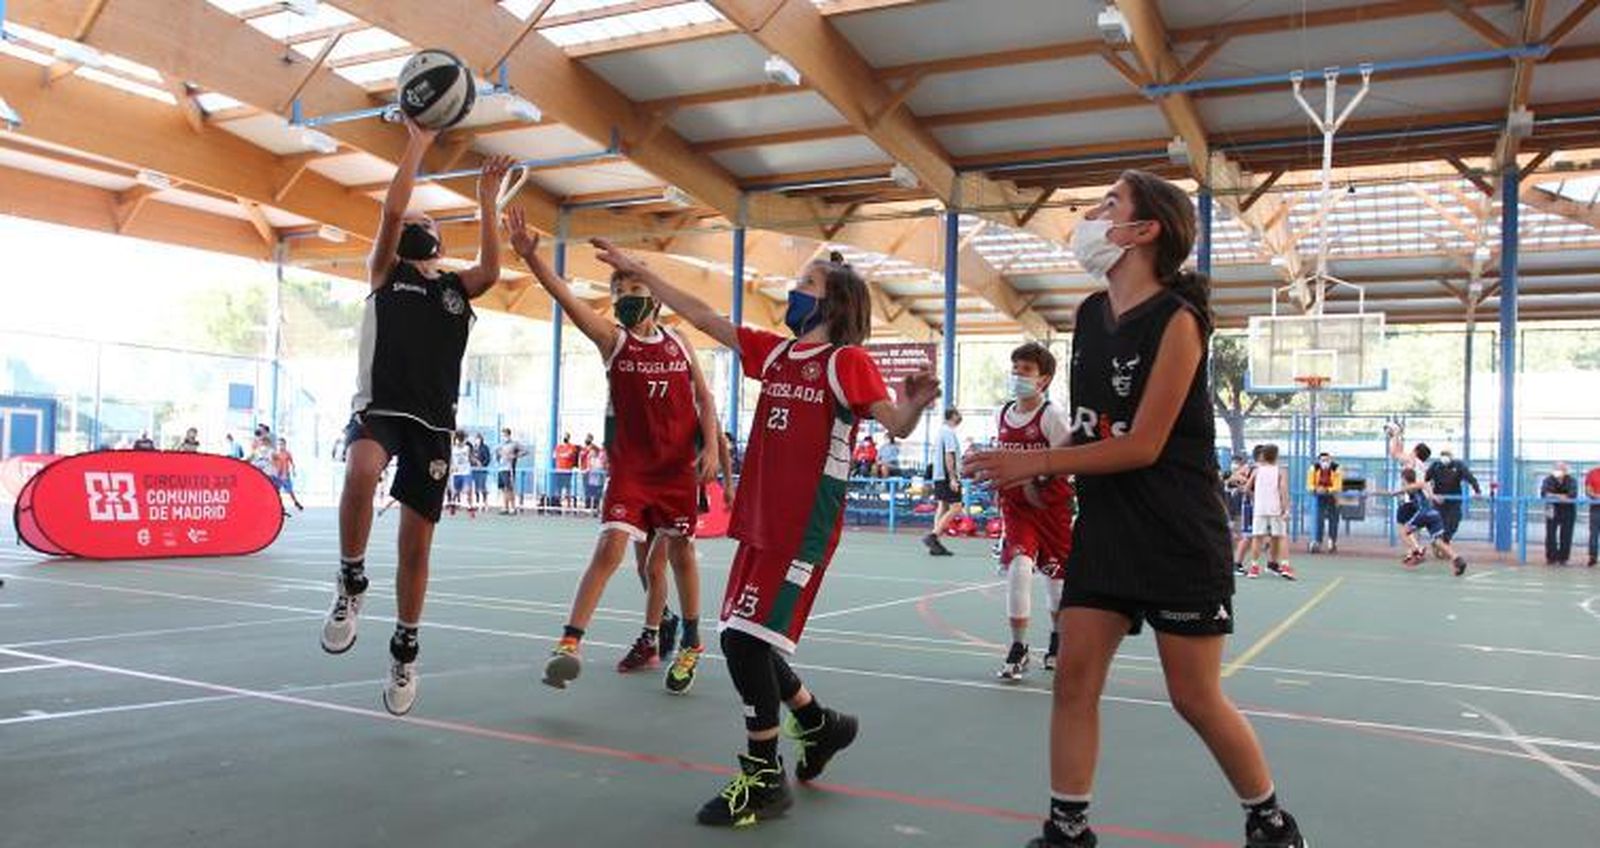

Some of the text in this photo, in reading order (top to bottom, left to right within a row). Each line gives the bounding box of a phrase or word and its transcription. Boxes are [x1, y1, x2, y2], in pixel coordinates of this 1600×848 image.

[647, 380, 669, 399] 77
[766, 407, 789, 430] 23
[146, 489, 230, 505] COMUNIDAD
[149, 505, 226, 520] DE MADRID
